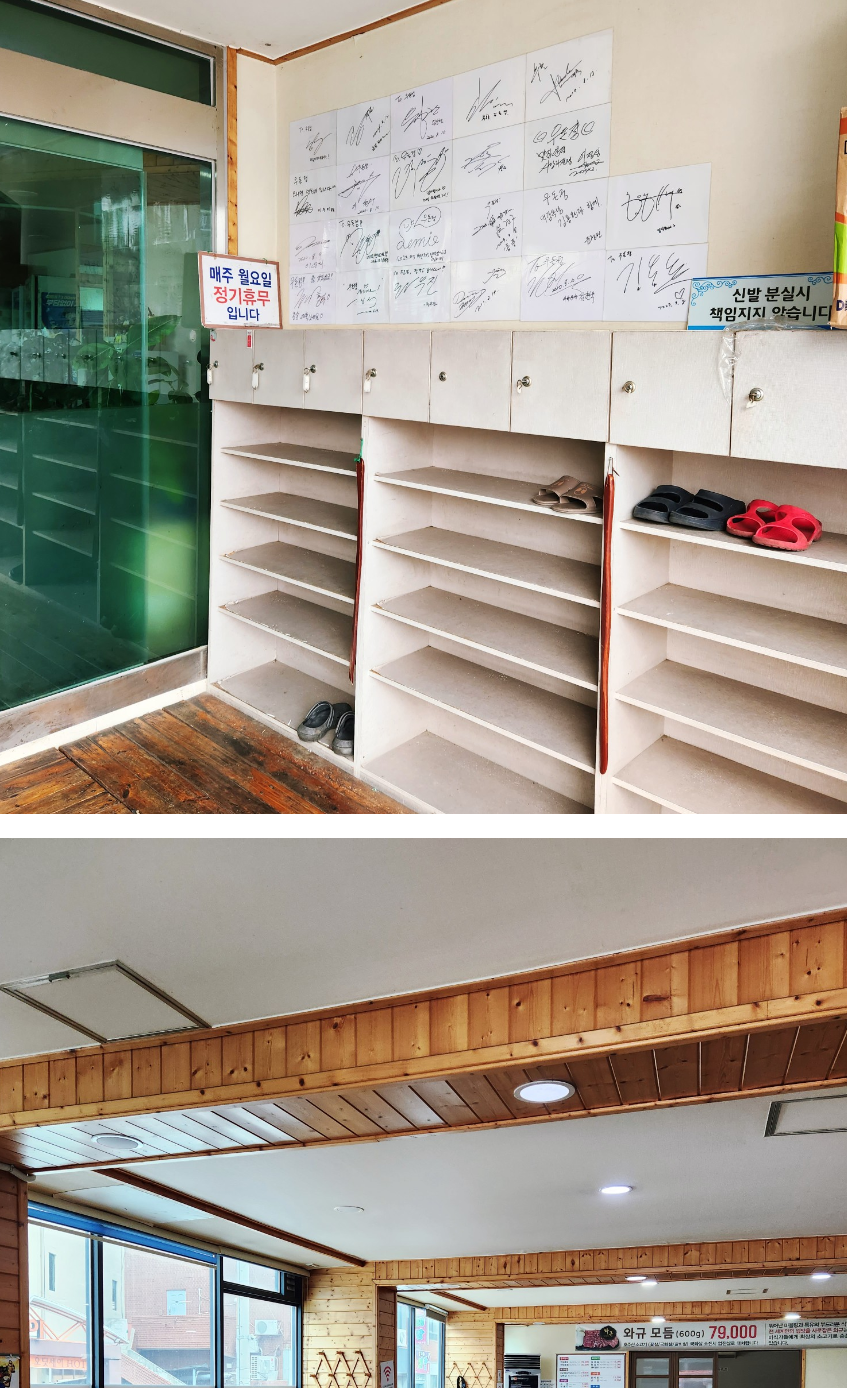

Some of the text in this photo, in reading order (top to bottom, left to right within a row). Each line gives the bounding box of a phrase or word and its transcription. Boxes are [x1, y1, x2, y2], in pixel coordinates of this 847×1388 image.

[210, 266, 272, 288] 매주 월요일
[213, 286, 270, 307] 정기휴무
[732, 285, 811, 303] 신발 분실시
[227, 306, 260, 321] 입니다
[709, 306, 766, 322] 책임지지
[623, 1325, 758, 1340] 와규 모듬 (600g) 79,000
